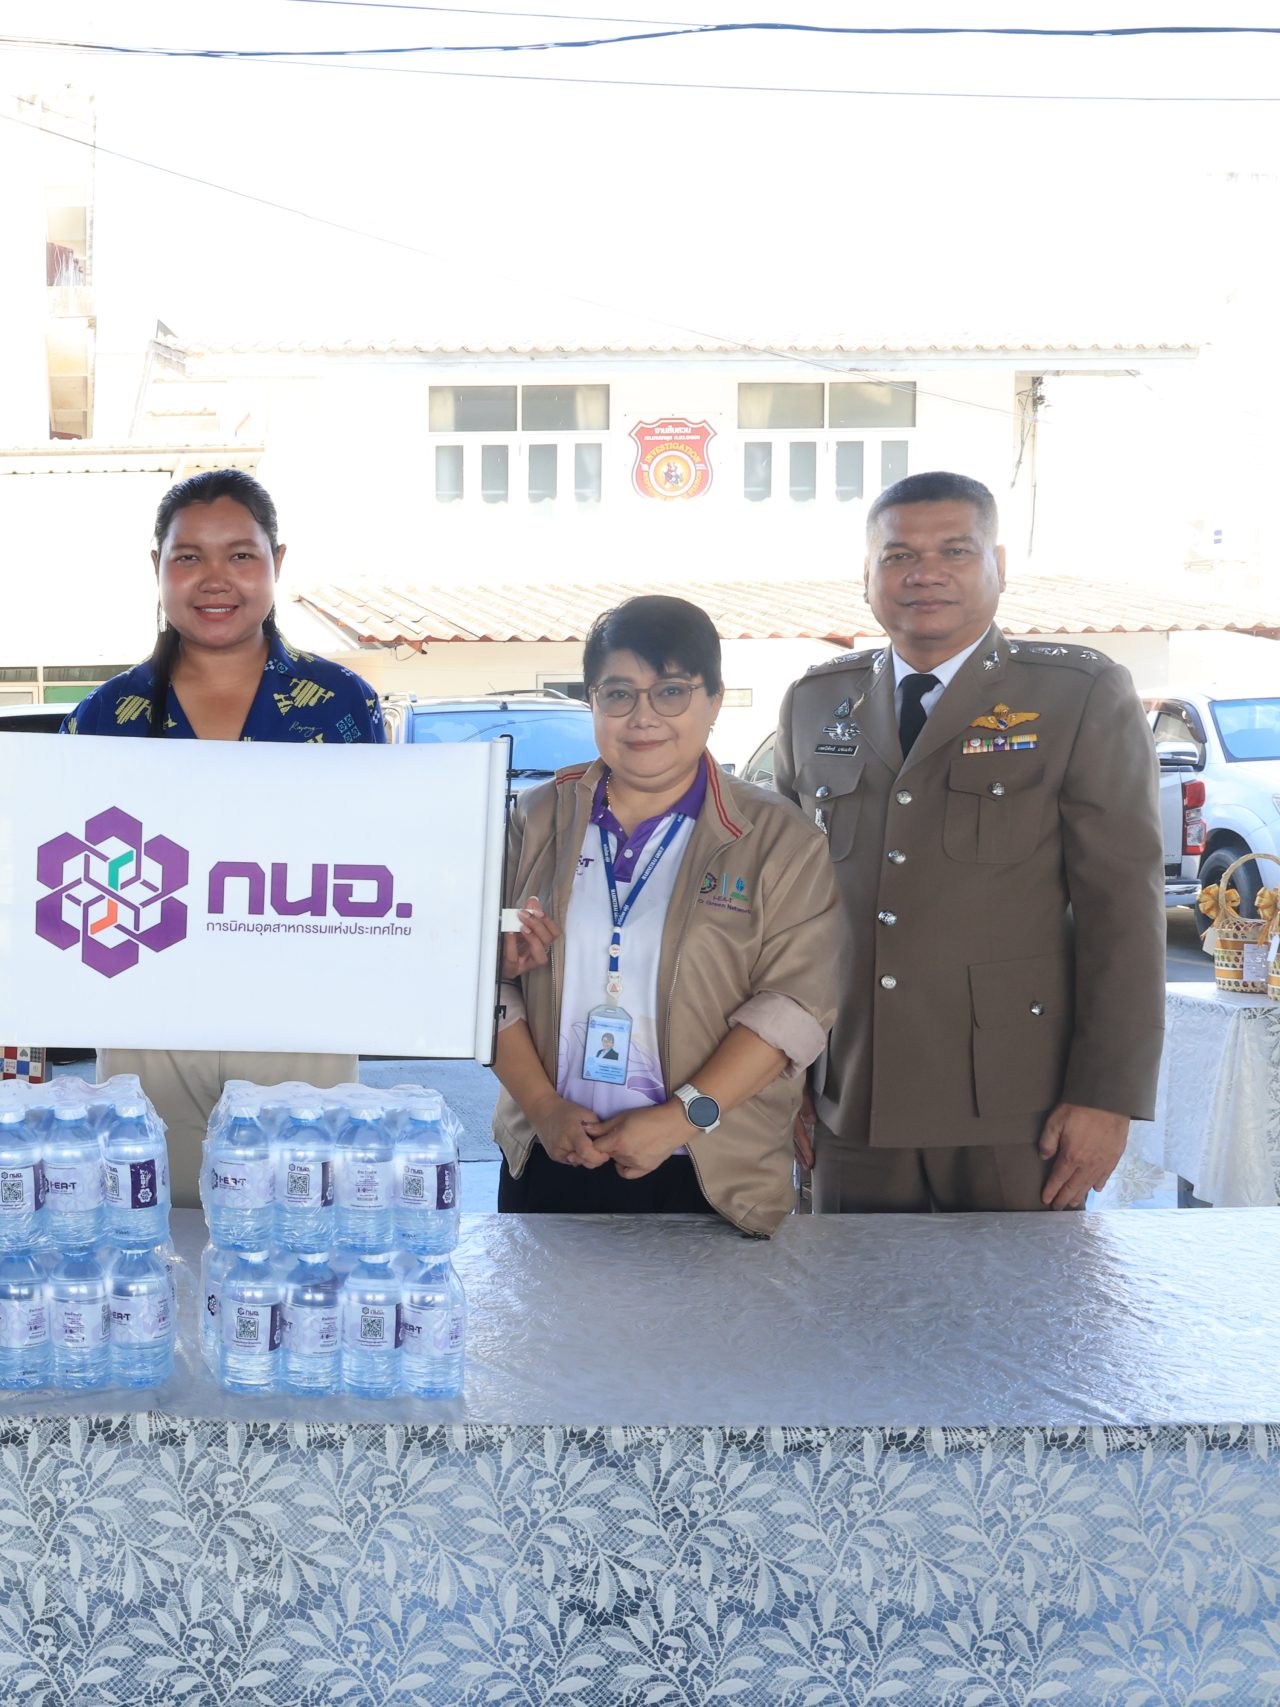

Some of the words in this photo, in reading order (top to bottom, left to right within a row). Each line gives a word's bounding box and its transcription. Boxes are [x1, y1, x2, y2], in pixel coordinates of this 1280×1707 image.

[645, 442, 701, 463] INVESTIGATION
[207, 861, 413, 918] กนอ.
[206, 918, 412, 937] การนิคมอุตสาหกรรมแห่งประเทศไทย
